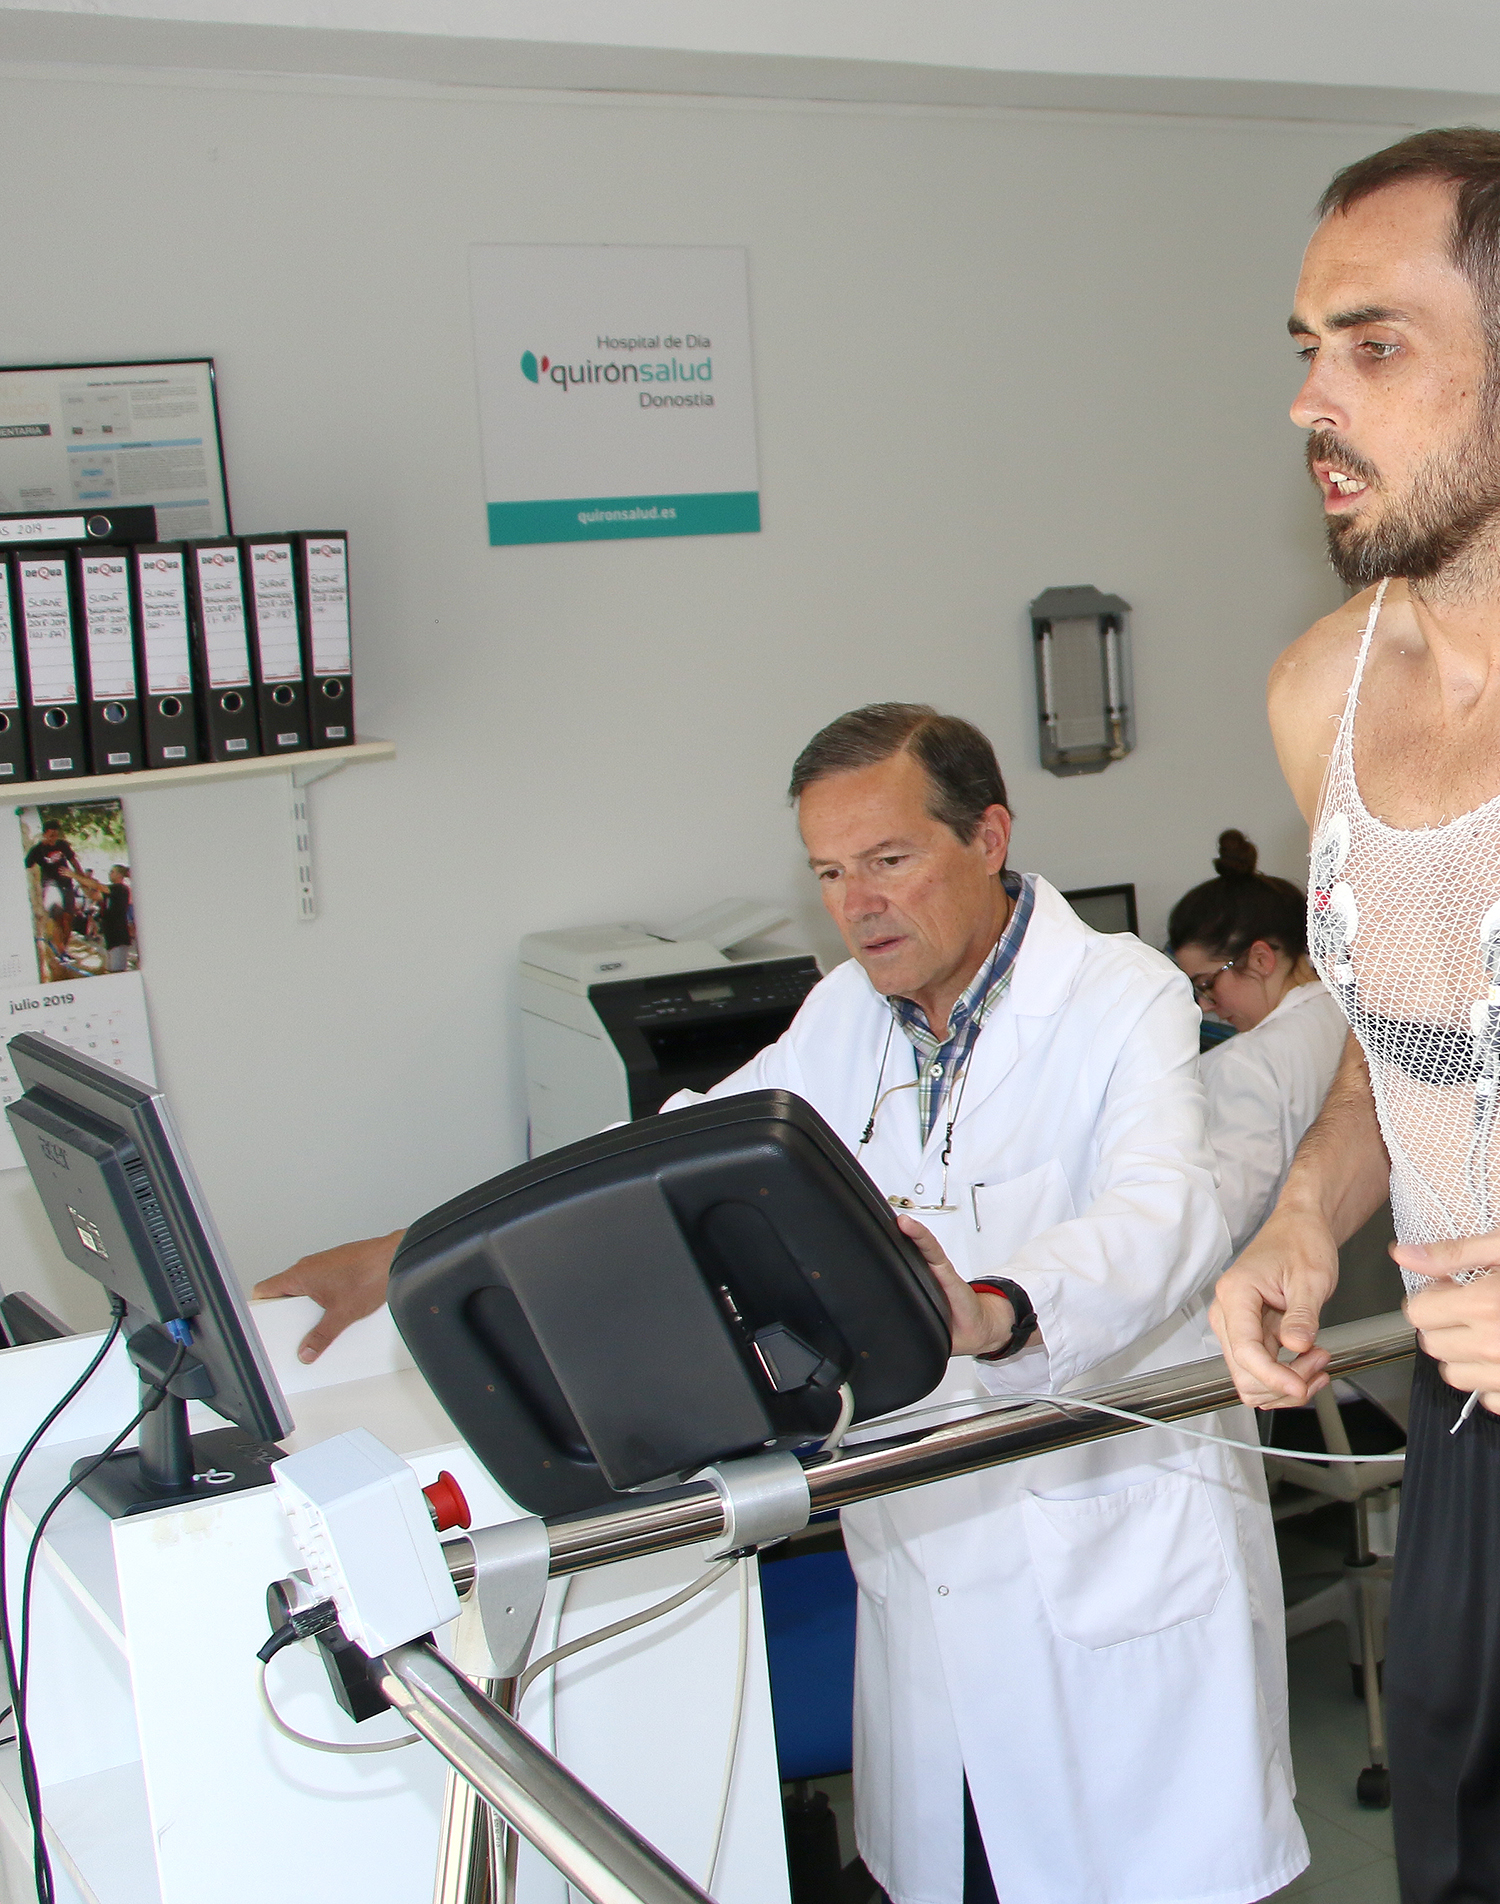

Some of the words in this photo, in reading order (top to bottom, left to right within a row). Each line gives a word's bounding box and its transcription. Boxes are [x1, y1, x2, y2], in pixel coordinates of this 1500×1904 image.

[597, 336, 660, 351] Hospital
[664, 335, 682, 348] de
[550, 357, 713, 392] quirónsalud
[639, 392, 714, 408] Donostia
[577, 506, 676, 524] quironsalud.es
[10, 998, 40, 1014] julio
[43, 993, 75, 1007] 2019
